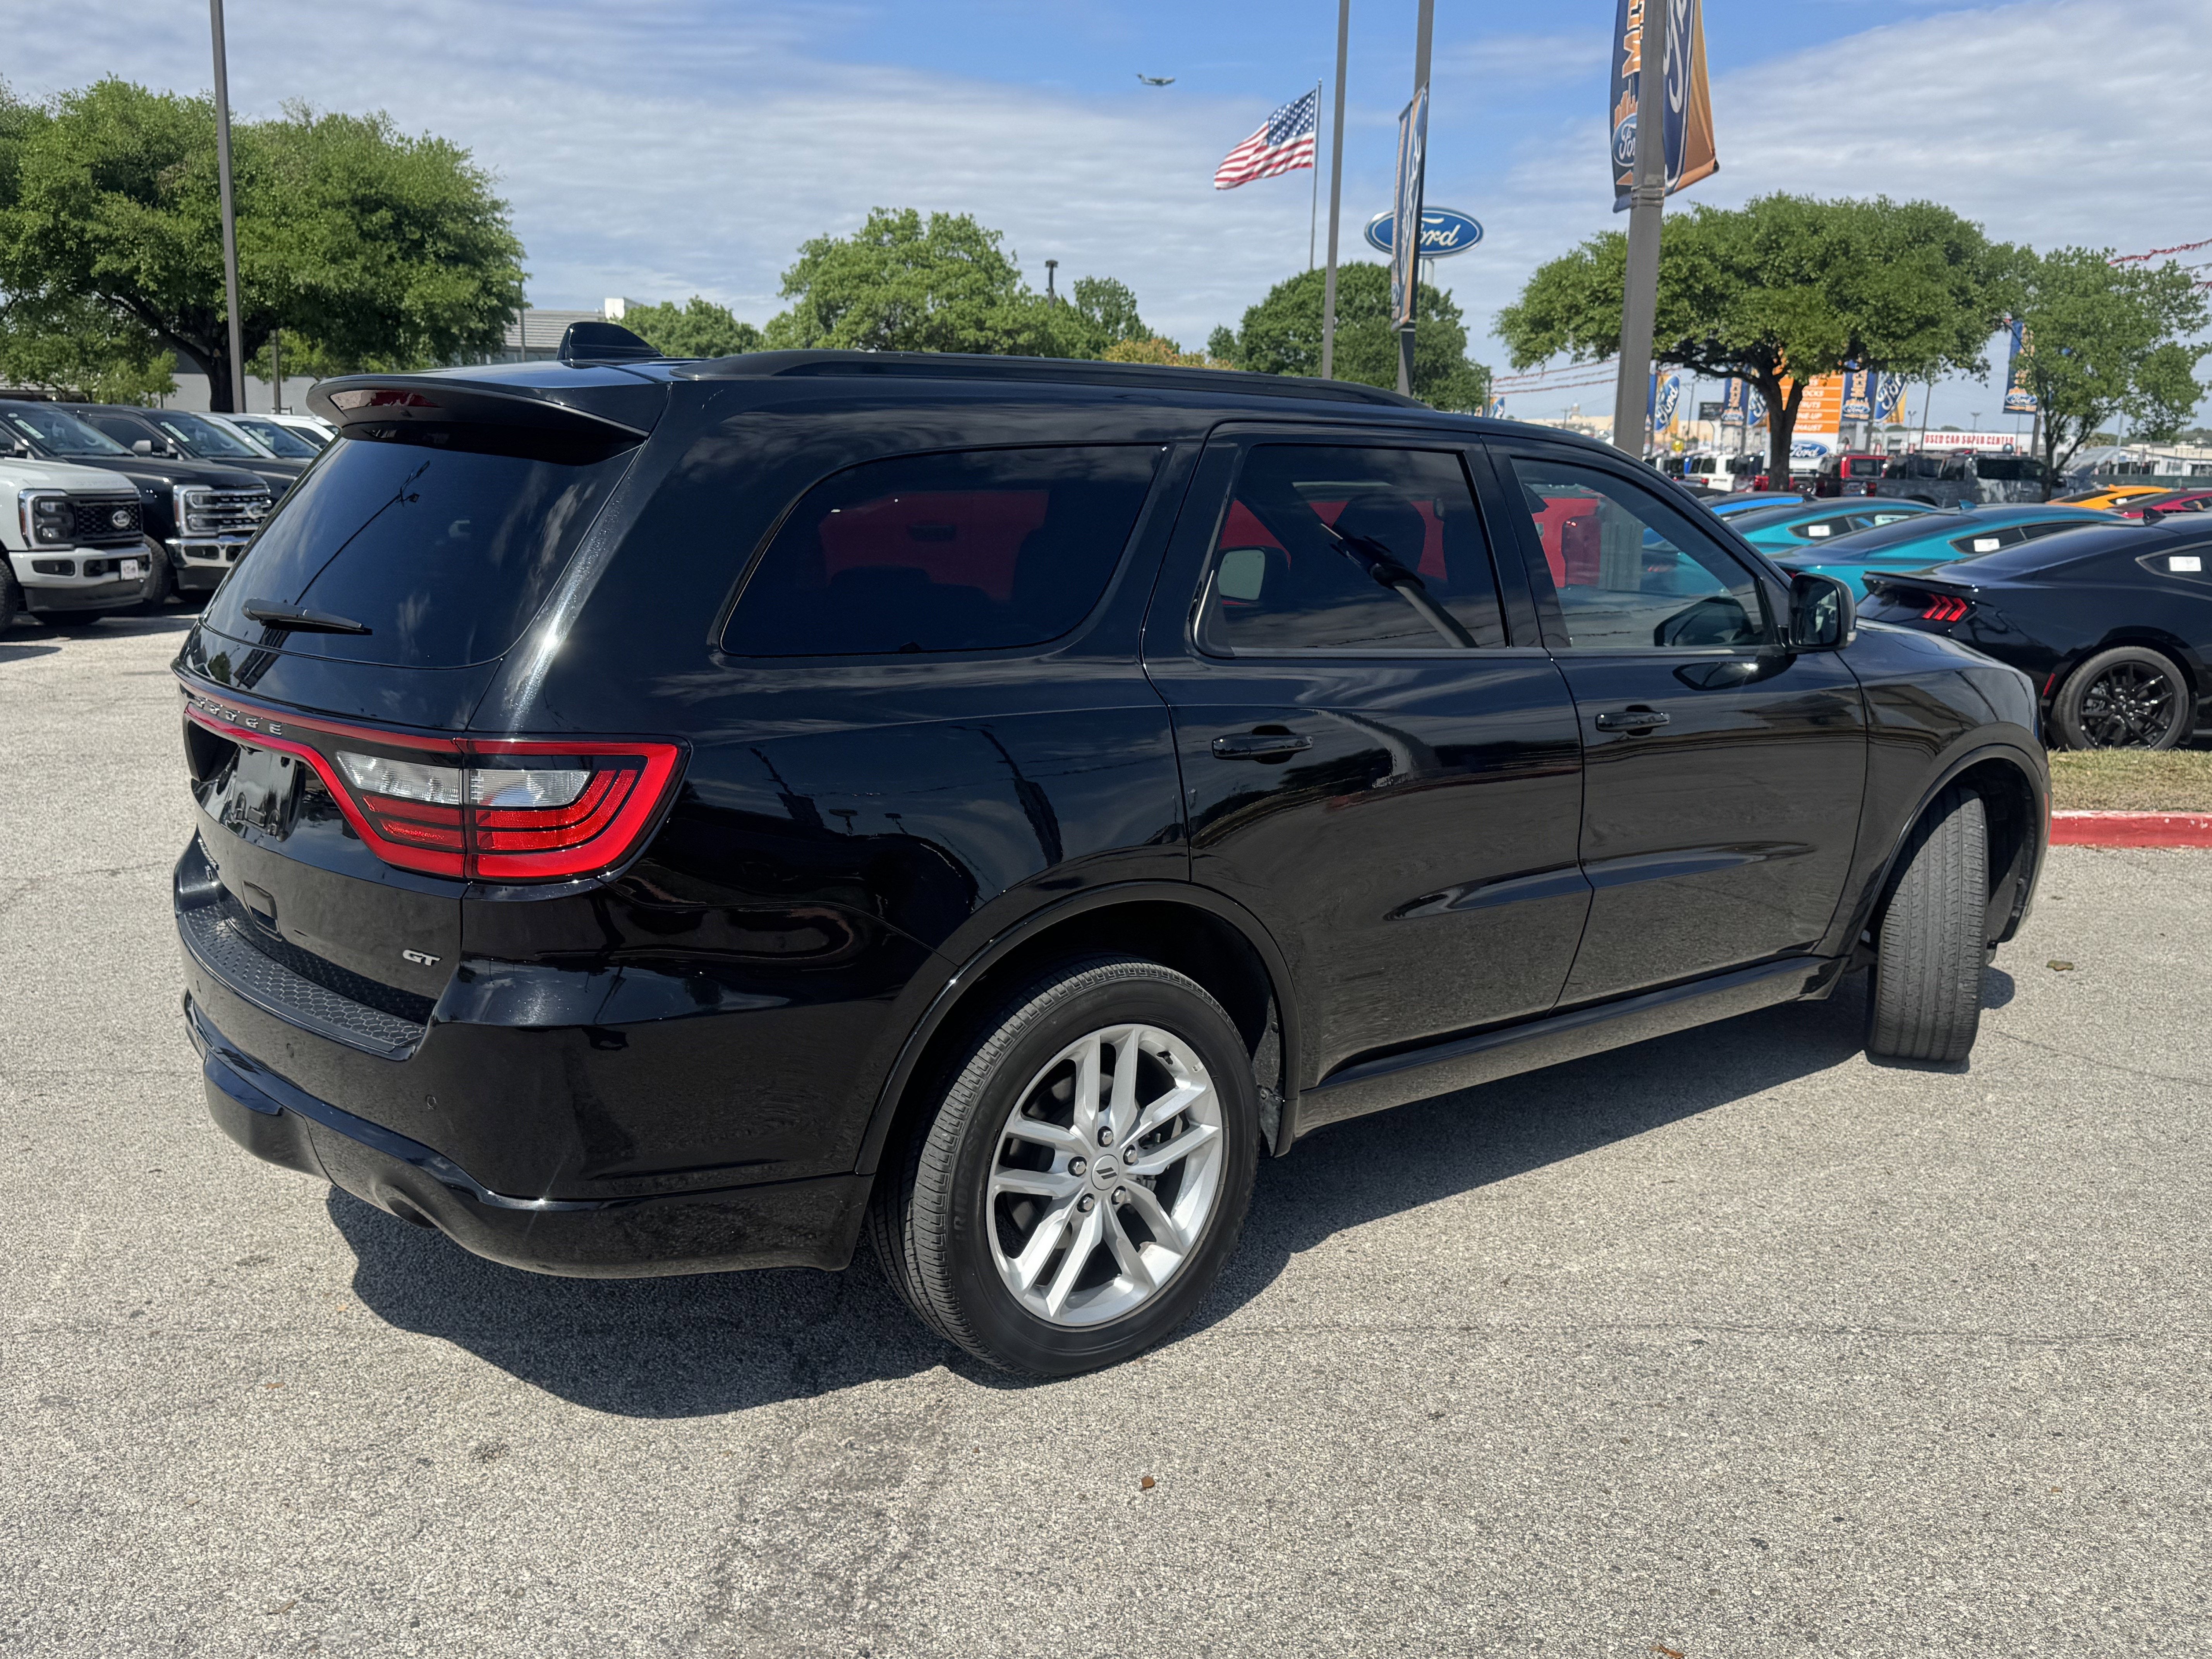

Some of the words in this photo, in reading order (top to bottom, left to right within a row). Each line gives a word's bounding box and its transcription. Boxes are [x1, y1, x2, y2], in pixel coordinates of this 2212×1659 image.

[1420, 218, 1461, 246] ord
[1655, 383, 1678, 424] Ford
[194, 696, 283, 736] DODGE
[403, 949, 441, 966] GT
